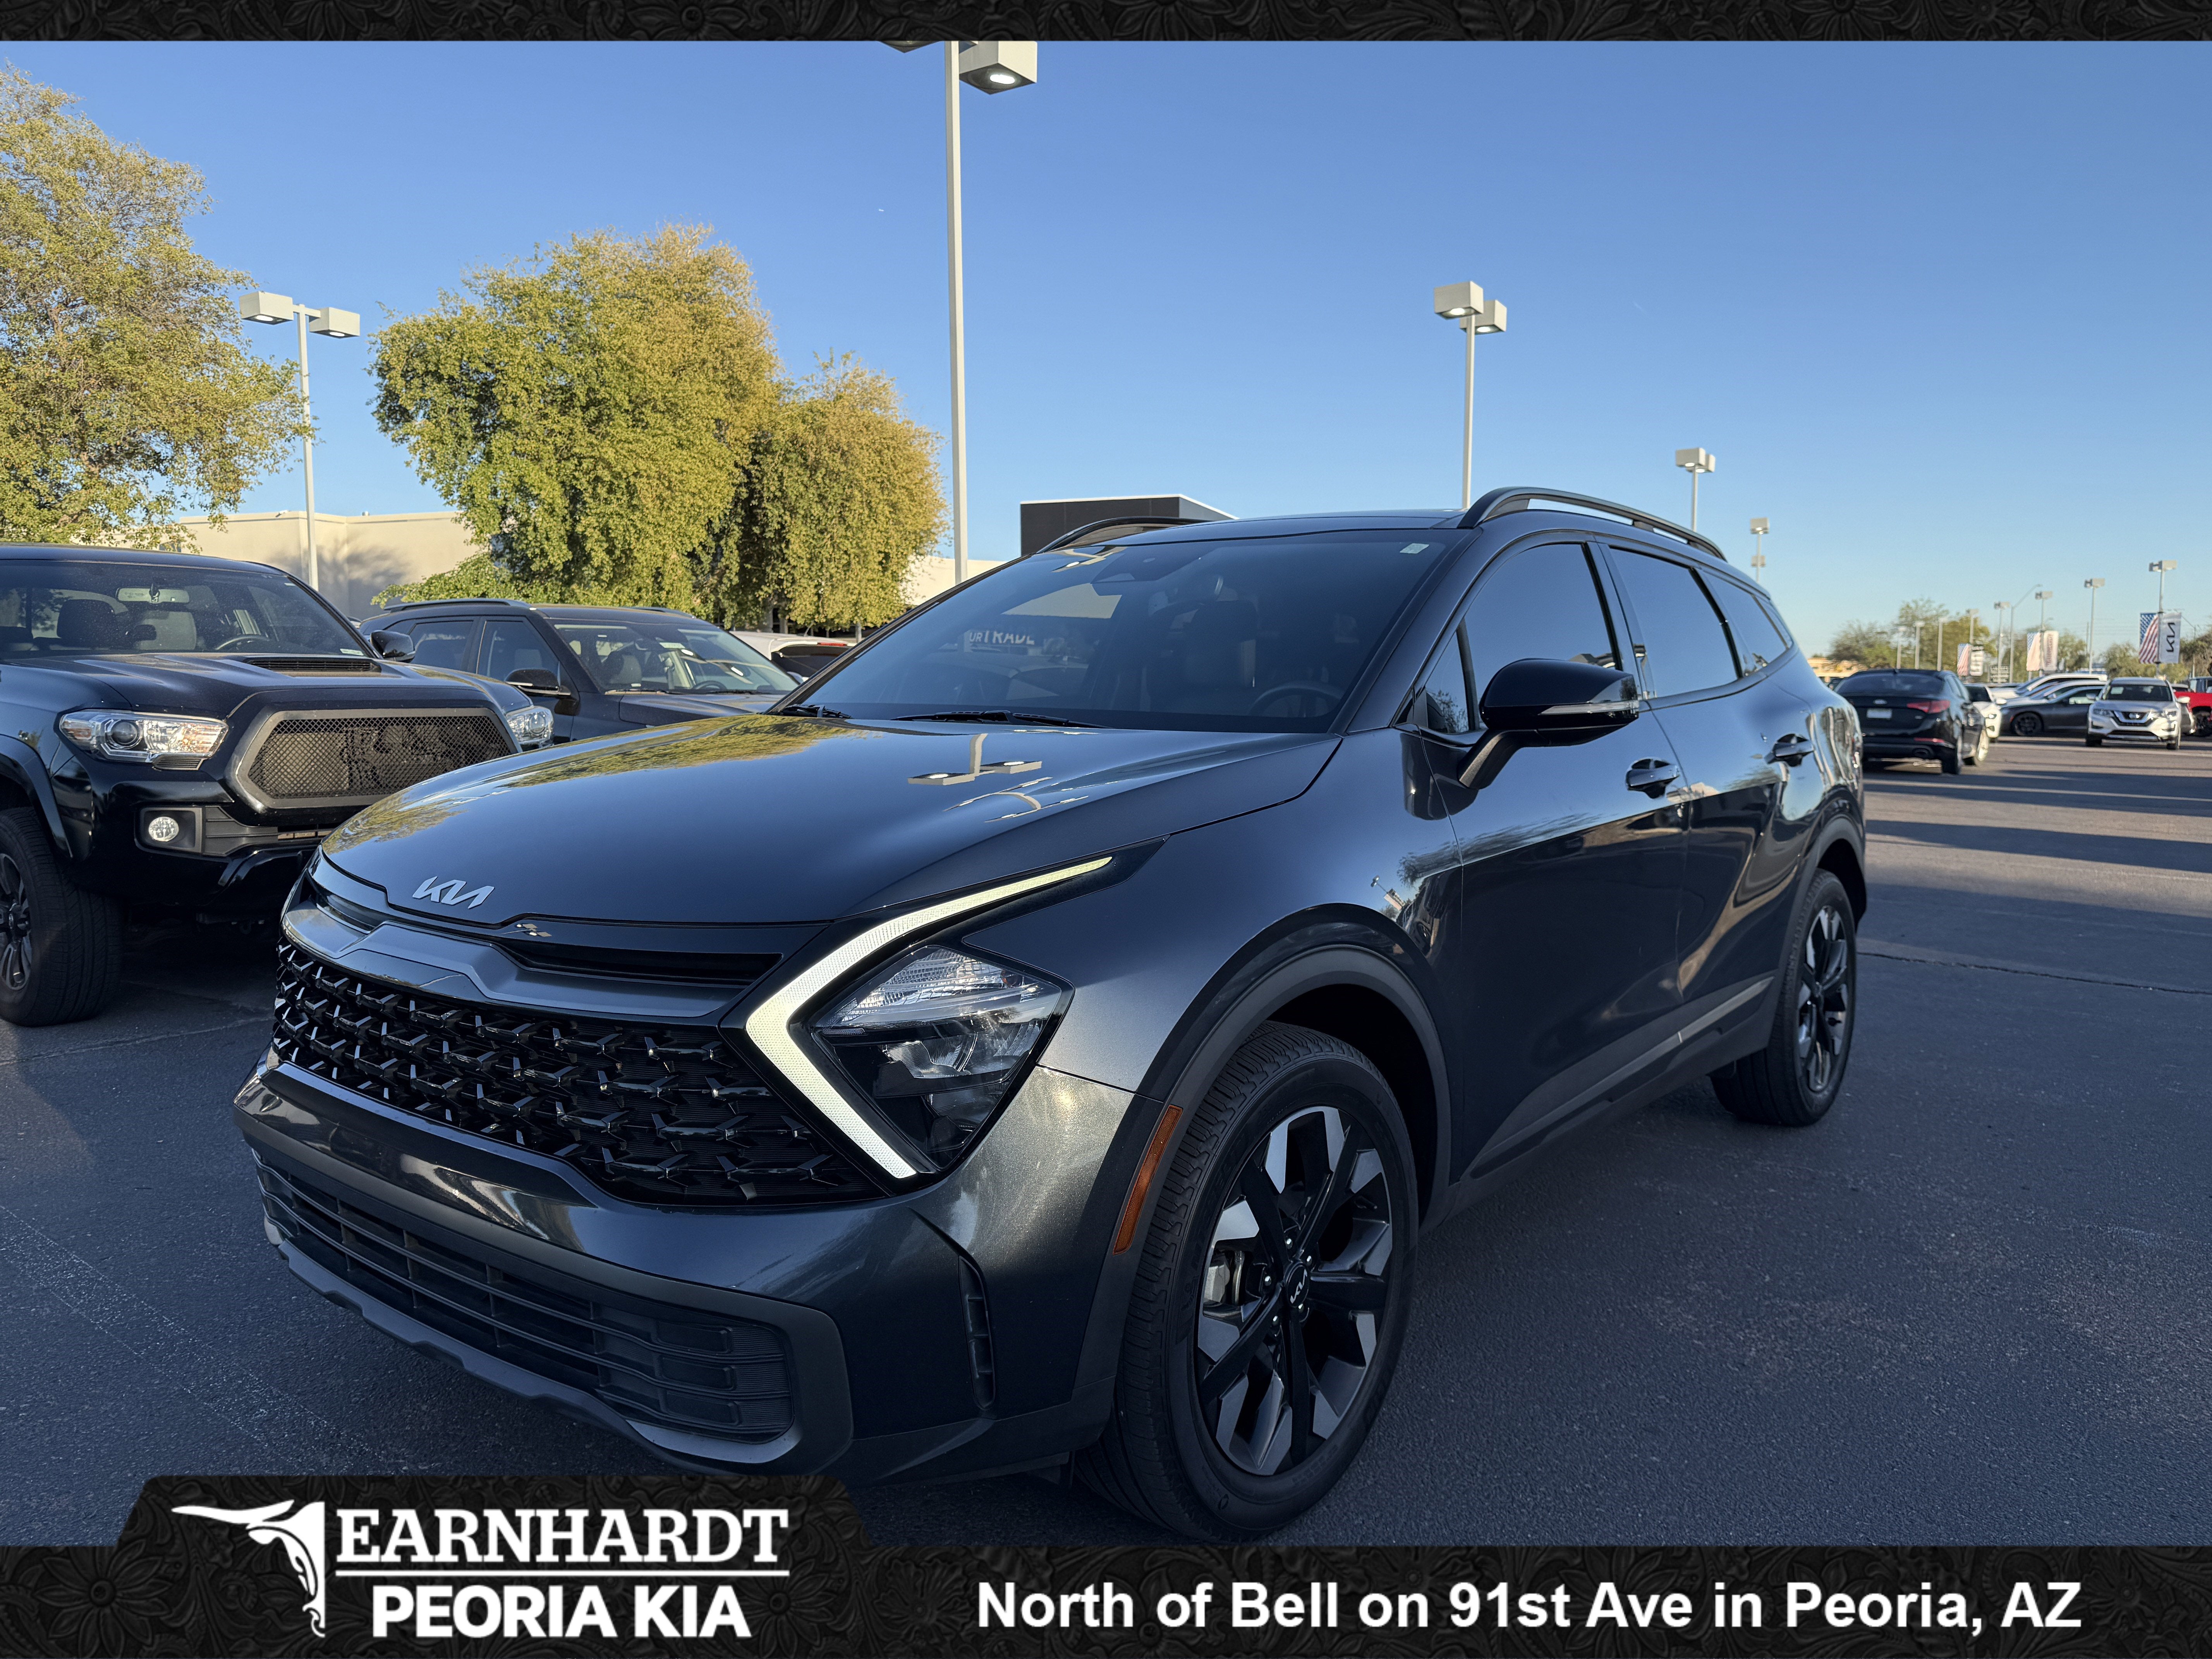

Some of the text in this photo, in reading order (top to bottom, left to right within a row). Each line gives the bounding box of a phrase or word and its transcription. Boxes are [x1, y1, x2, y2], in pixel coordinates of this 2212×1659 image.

[2166, 622, 2175, 652] KIA
[412, 876, 495, 909] KIA
[1290, 1268, 1307, 1304] KIA
